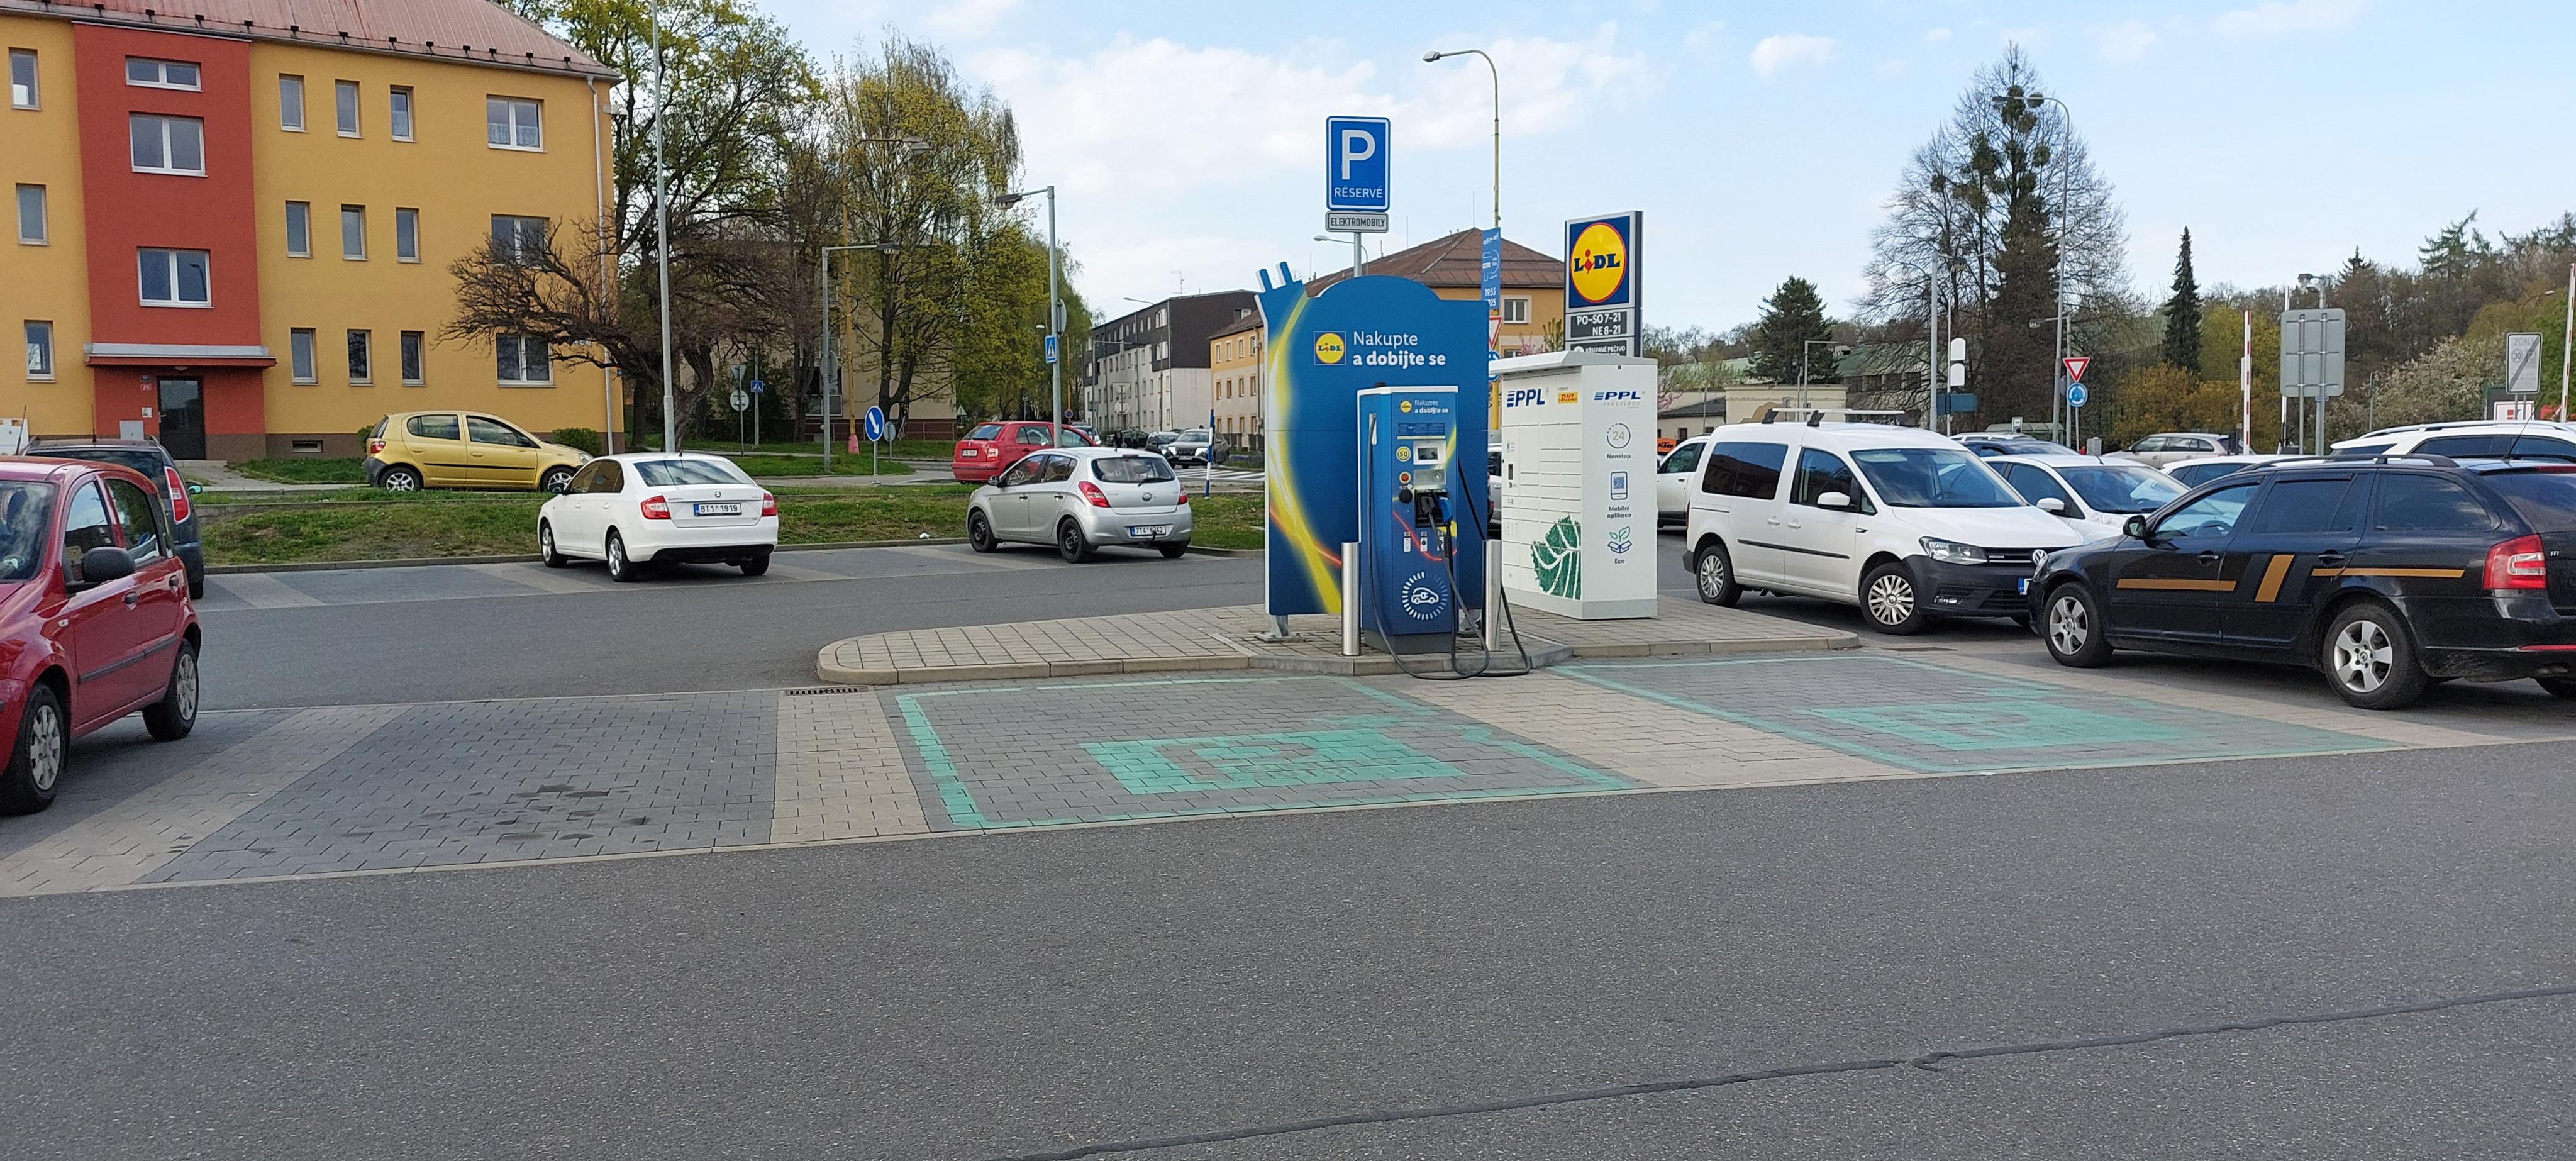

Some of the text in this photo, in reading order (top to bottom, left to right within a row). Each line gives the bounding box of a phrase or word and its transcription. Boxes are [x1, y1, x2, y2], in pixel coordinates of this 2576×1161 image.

[1341, 130, 1376, 180] P
[1334, 186, 1384, 199] RÉSERVÉ
[1330, 217, 1385, 228] ELEKTROMOBILY
[1604, 313, 1621, 323] 7-21
[1592, 325, 1621, 336] NE 8-21
[1353, 331, 1418, 349] Nakupte
[1353, 350, 1446, 369] a dobijte se
[1515, 388, 1545, 407] PPL
[1604, 391, 1641, 401] PPL
[1612, 430, 1625, 441] 24
[720, 504, 738, 513] 1919
